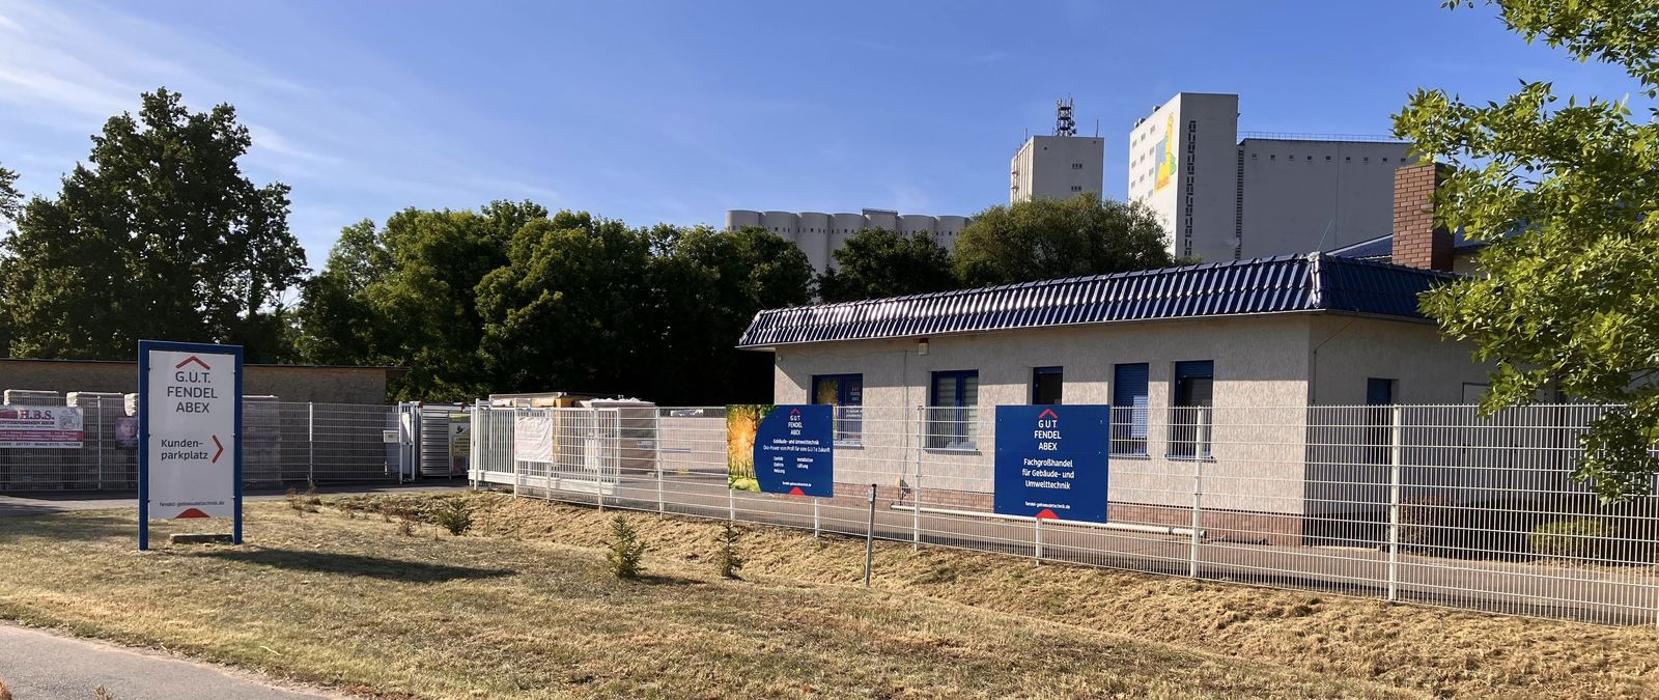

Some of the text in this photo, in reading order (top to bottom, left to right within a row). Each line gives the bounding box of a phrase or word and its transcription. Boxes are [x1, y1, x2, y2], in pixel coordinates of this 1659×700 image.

[175, 371, 211, 384] G.U.T.
[167, 386, 218, 399] FENDEL
[175, 401, 210, 413] ABEX
[19, 410, 55, 420] H.B.S.
[1034, 430, 1062, 439] FENDEL
[161, 439, 204, 448] Kunden-
[1038, 442, 1058, 451] ABEX
[161, 451, 208, 461] parkplatz
[1023, 458, 1073, 468] Fachgroßhandel
[1022, 468, 1075, 479] für Gebäude- und
[1025, 480, 1071, 489] Umwelttechnik
